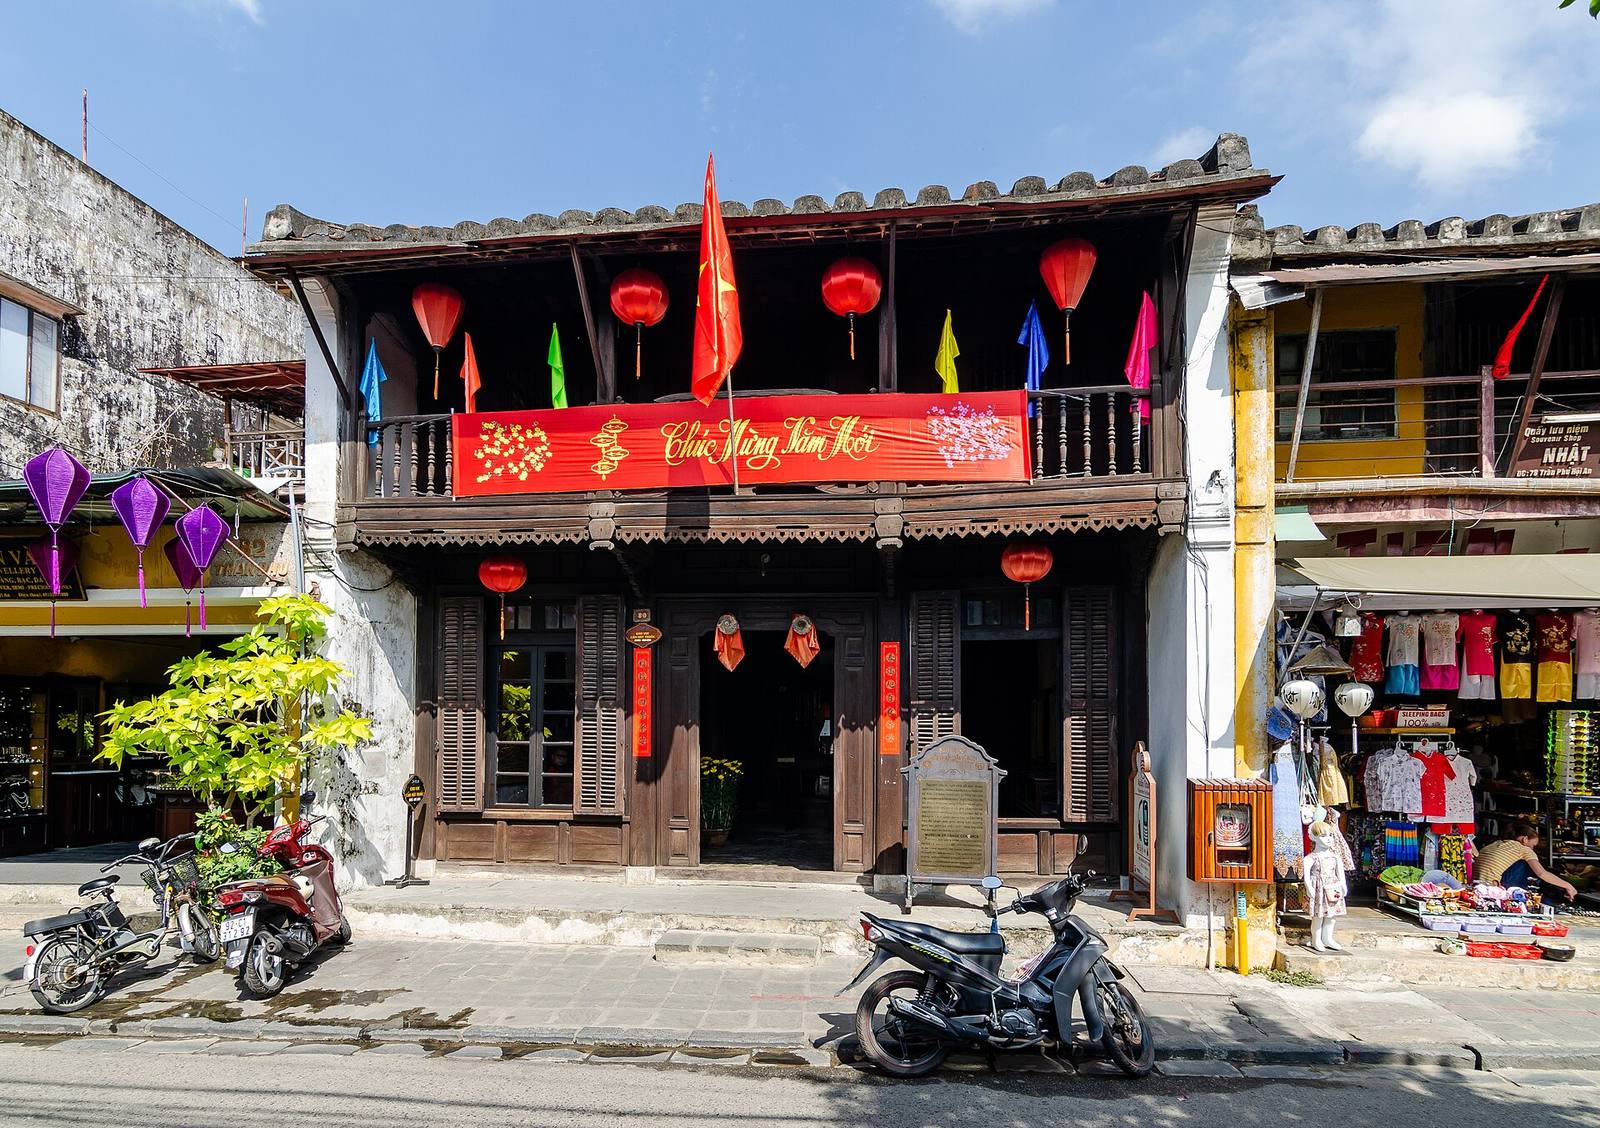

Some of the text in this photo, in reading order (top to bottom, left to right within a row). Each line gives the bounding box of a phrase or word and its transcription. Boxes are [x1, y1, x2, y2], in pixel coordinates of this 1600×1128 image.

[660, 415, 881, 470] Chúc Mừng Năm Mới
[1530, 434, 1582, 444] Souvenir Shop
[1542, 443, 1591, 465] NHẬT
[1404, 718, 1429, 727] 100%
